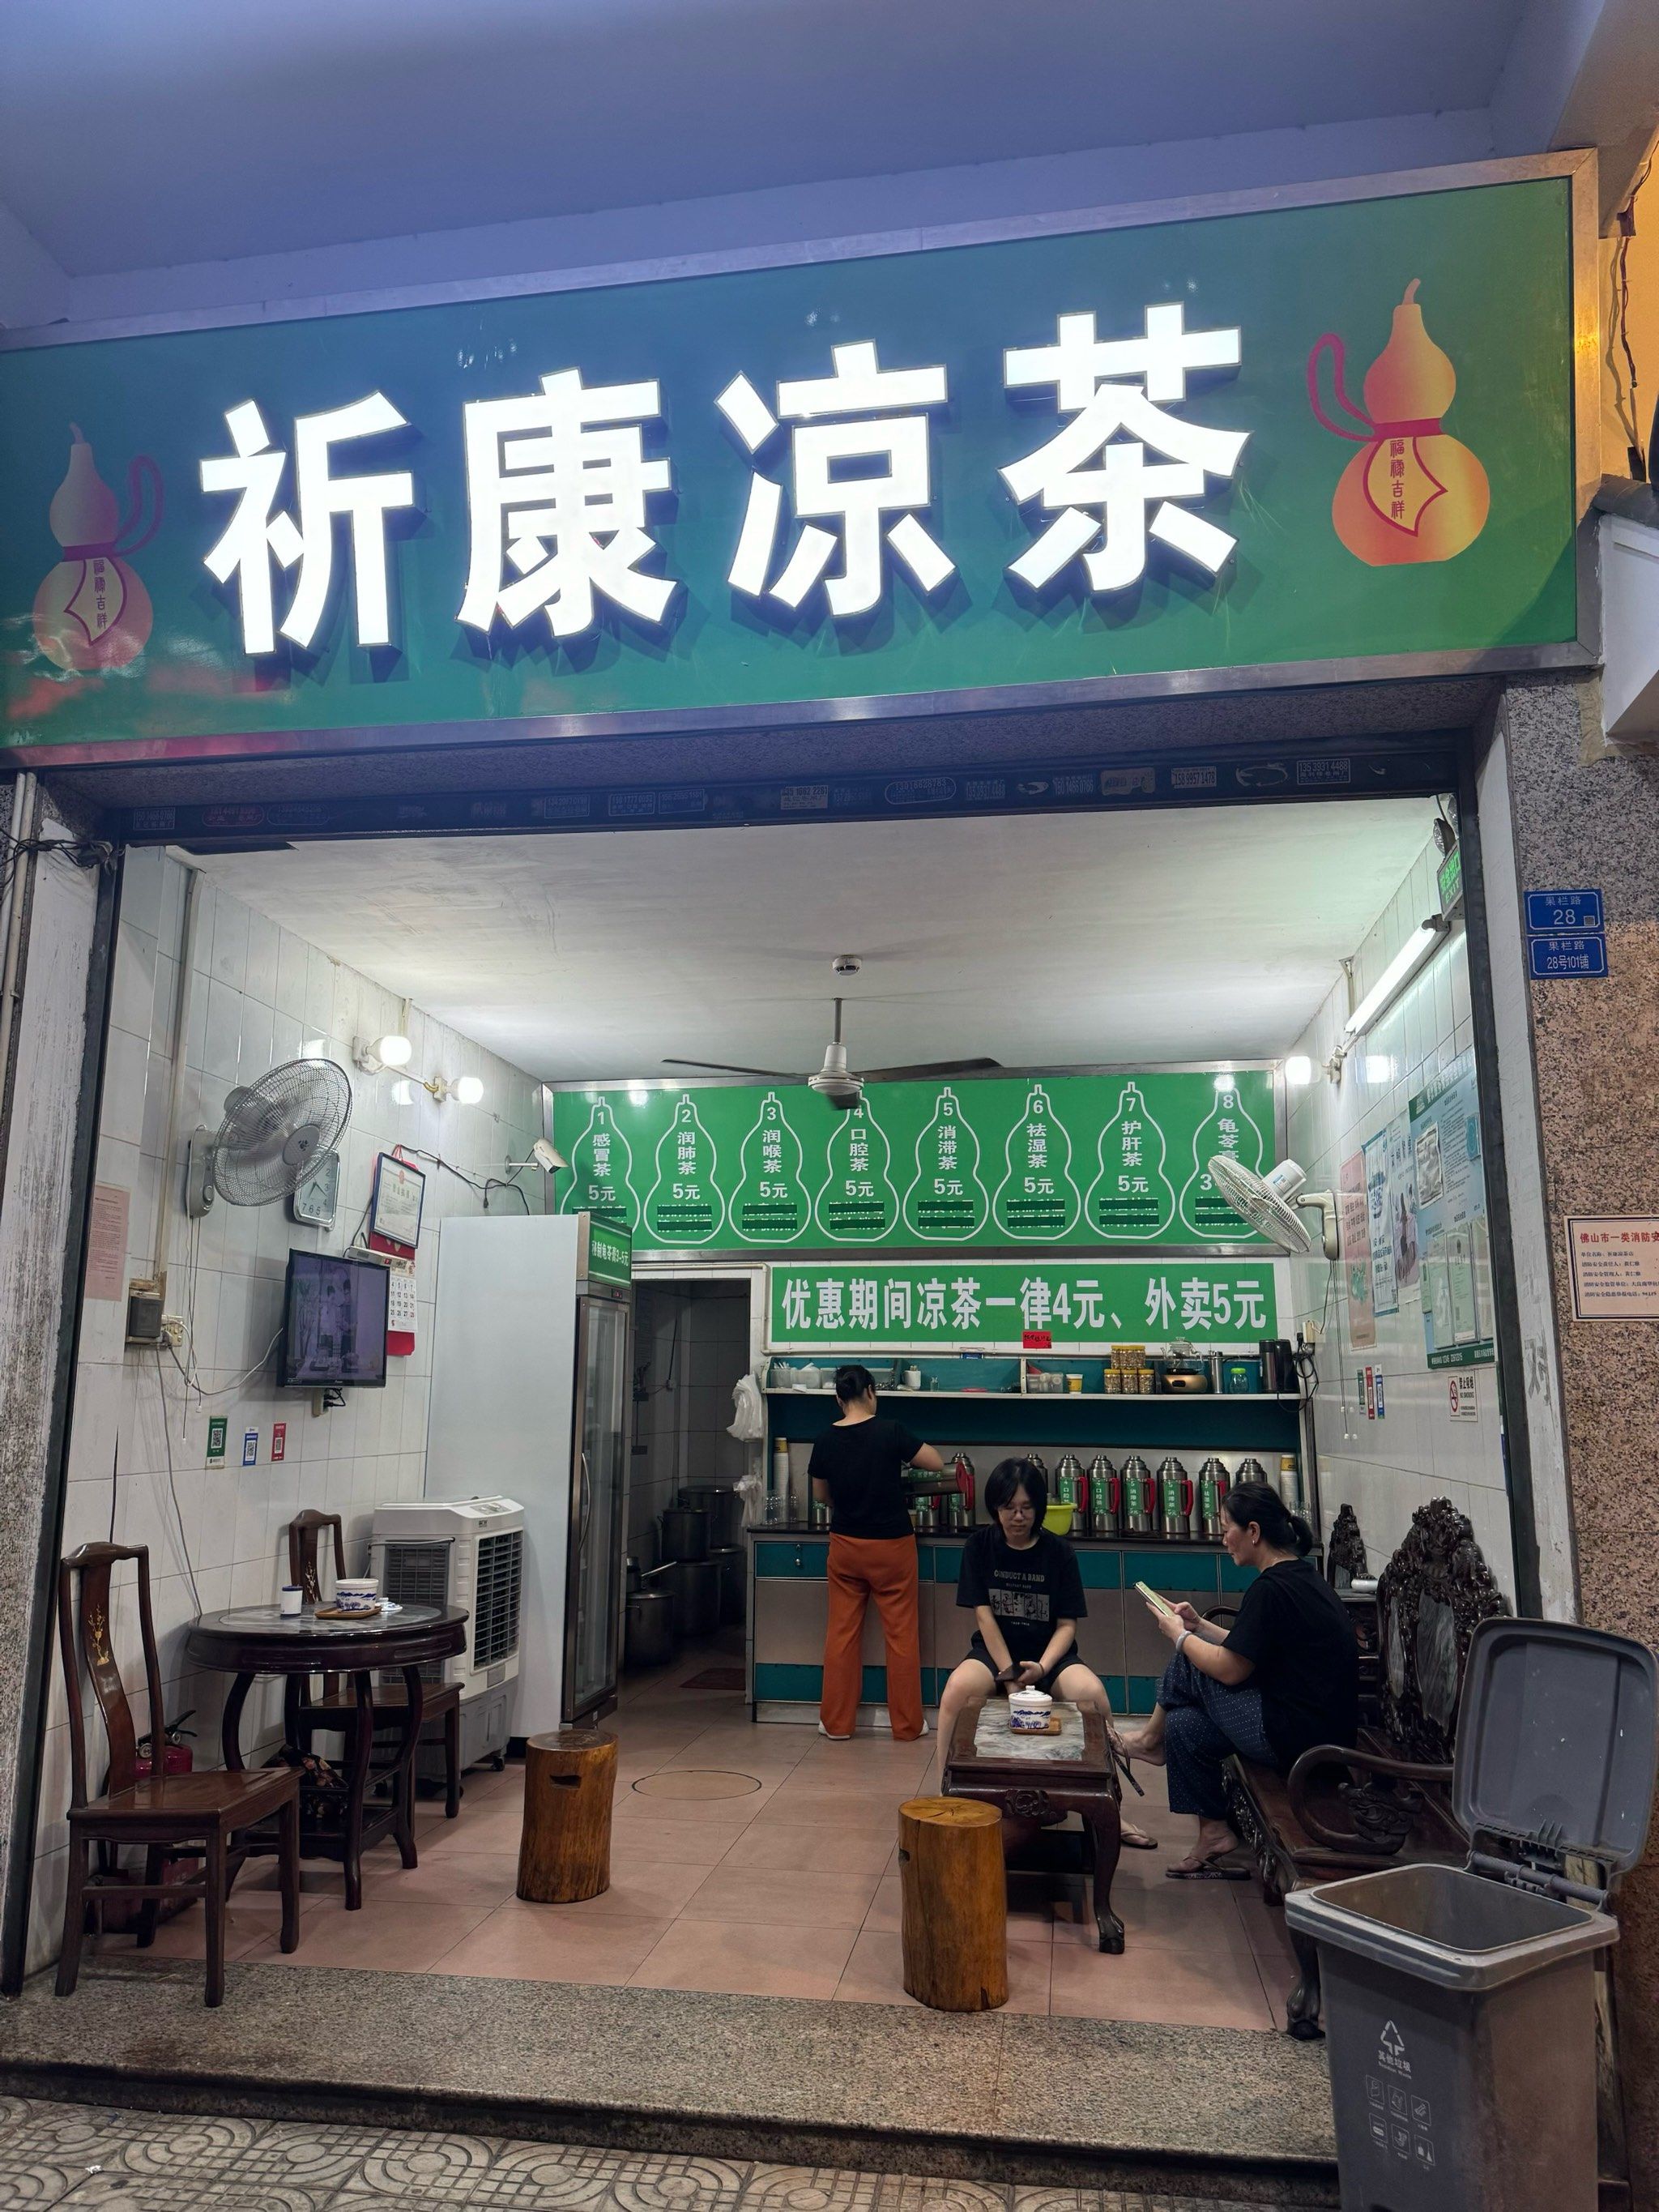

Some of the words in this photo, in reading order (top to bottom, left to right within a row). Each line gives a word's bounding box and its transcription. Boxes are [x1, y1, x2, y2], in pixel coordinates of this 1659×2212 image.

[199, 301, 1250, 657] 祈康凉茶
[1331, 760, 1348, 770] 4488
[1440, 852, 1461, 895] 安全出口
[1445, 878, 1459, 904] EXIT
[1546, 895, 1581, 907] 果栏路
[1553, 909, 1576, 925] 28
[1549, 941, 1585, 951] 果栏路
[1546, 954, 1589, 971] 28号101铺
[943, 1102, 953, 1116] 5
[1033, 1100, 1043, 1114] 6
[1126, 1097, 1136, 1112] 7
[1223, 1095, 1234, 1108] 8
[597, 1111, 606, 1125] 1
[681, 1108, 692, 1123] 2
[766, 1107, 777, 1121] 3
[854, 1105, 864, 1118] 4
[762, 1129, 782, 1173] 润喉茶
[849, 1128, 869, 1172] 口腔茶
[937, 1125, 957, 1170] 消滞茶
[1026, 1123, 1047, 1168] 祛湿茶
[1122, 1121, 1143, 1167] 护肝茶
[592, 1134, 612, 1176] 感冒茶
[677, 1131, 696, 1175] 润肺茶
[589, 1185, 616, 1201] 5元
[672, 1183, 701, 1200] 5元
[760, 1181, 787, 1199] 5元
[845, 1180, 874, 1197] 5元
[934, 1178, 963, 1196] 5元
[1024, 1176, 1054, 1195] 5元
[1119, 1175, 1149, 1195] 5元
[1580, 1231, 1659, 1244] 佛山市一类消防安
[1028, 1574, 1045, 1582] BAND
